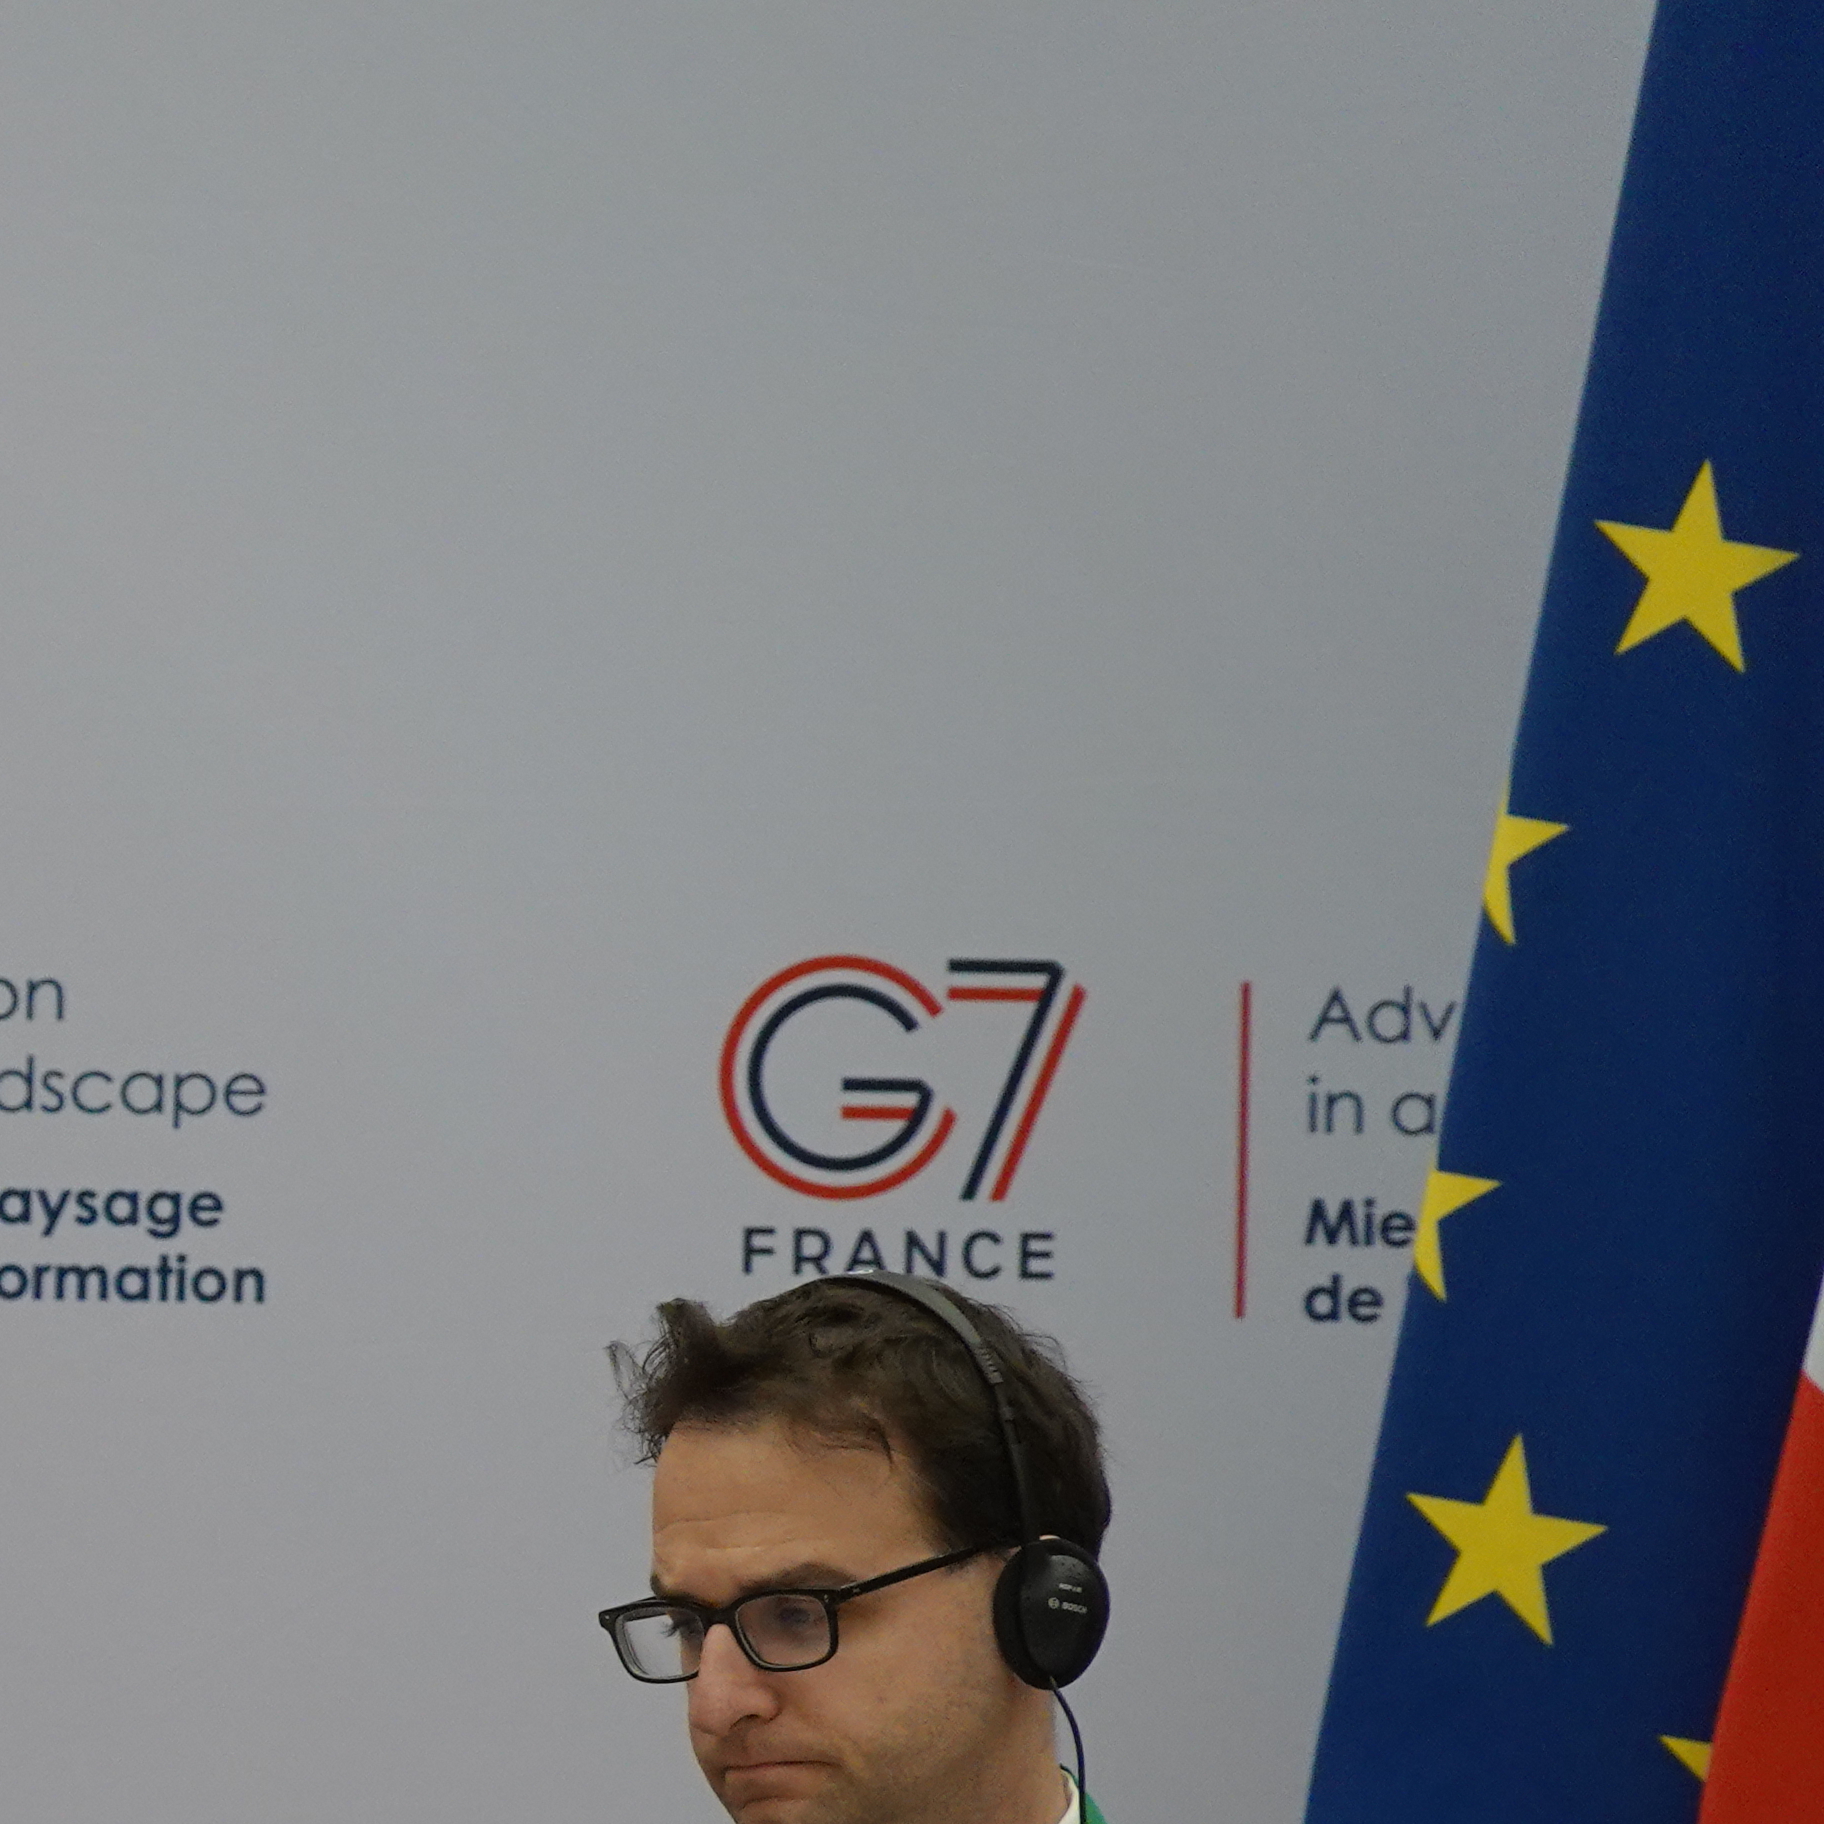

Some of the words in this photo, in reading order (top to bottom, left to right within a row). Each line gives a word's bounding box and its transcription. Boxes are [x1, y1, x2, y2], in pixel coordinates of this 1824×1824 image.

[1308, 984, 1456, 1042] Adv
[719, 954, 1086, 1201] G7
[1307, 1074, 1365, 1135] in
[1391, 1091, 1436, 1136] a
[1304, 1197, 1416, 1249] Mie
[742, 1227, 1055, 1280] FRANCE
[1303, 1272, 1385, 1325] de
